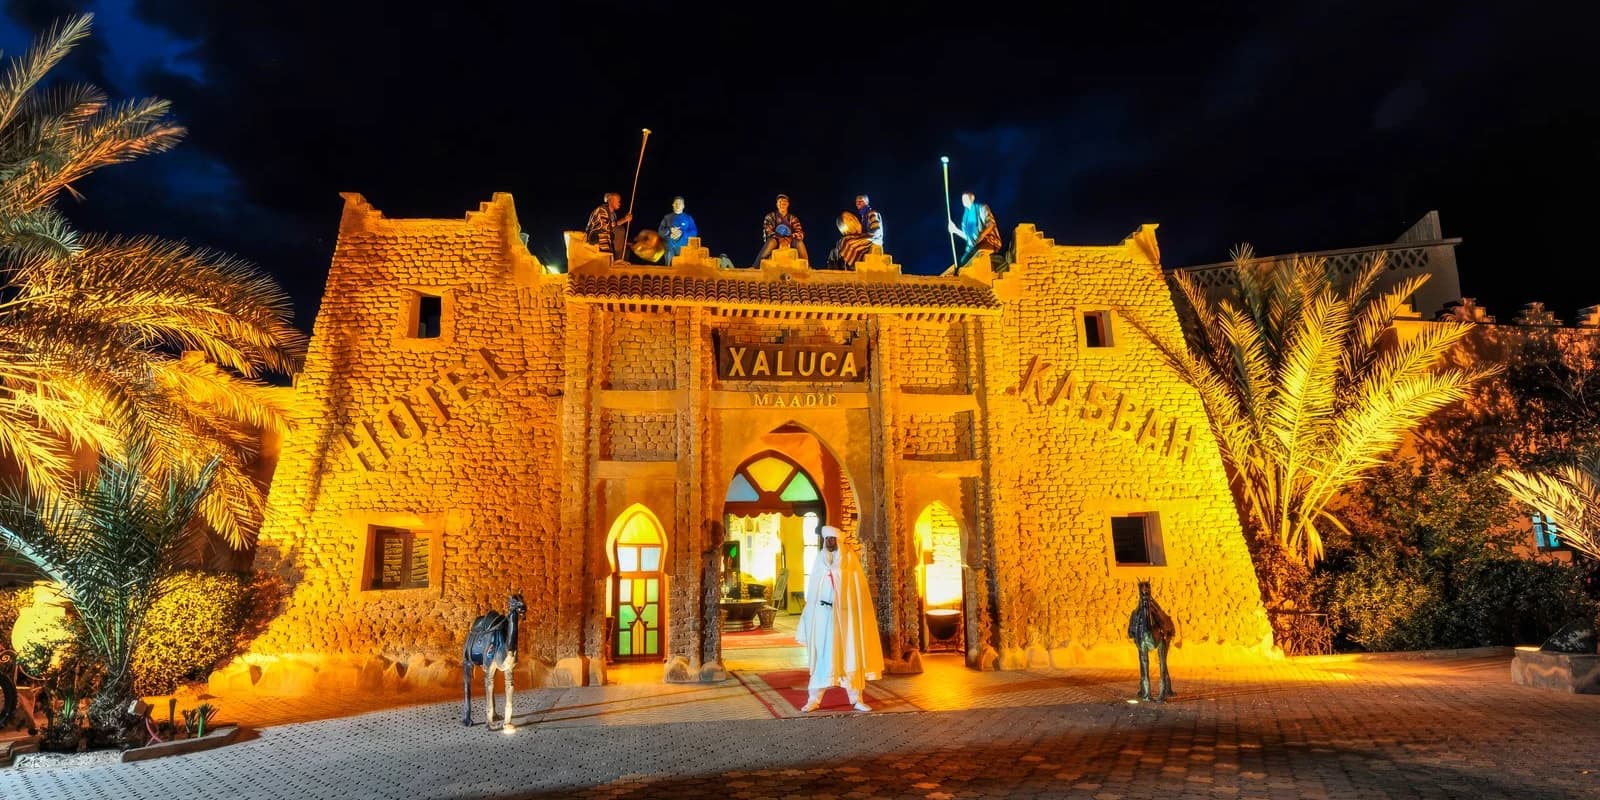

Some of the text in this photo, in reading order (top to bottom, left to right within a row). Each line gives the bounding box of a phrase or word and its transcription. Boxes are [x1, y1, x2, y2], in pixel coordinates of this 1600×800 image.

[339, 347, 525, 472] HOTEL
[728, 347, 858, 377] XALUCA
[1018, 355, 1196, 465] KASBAH
